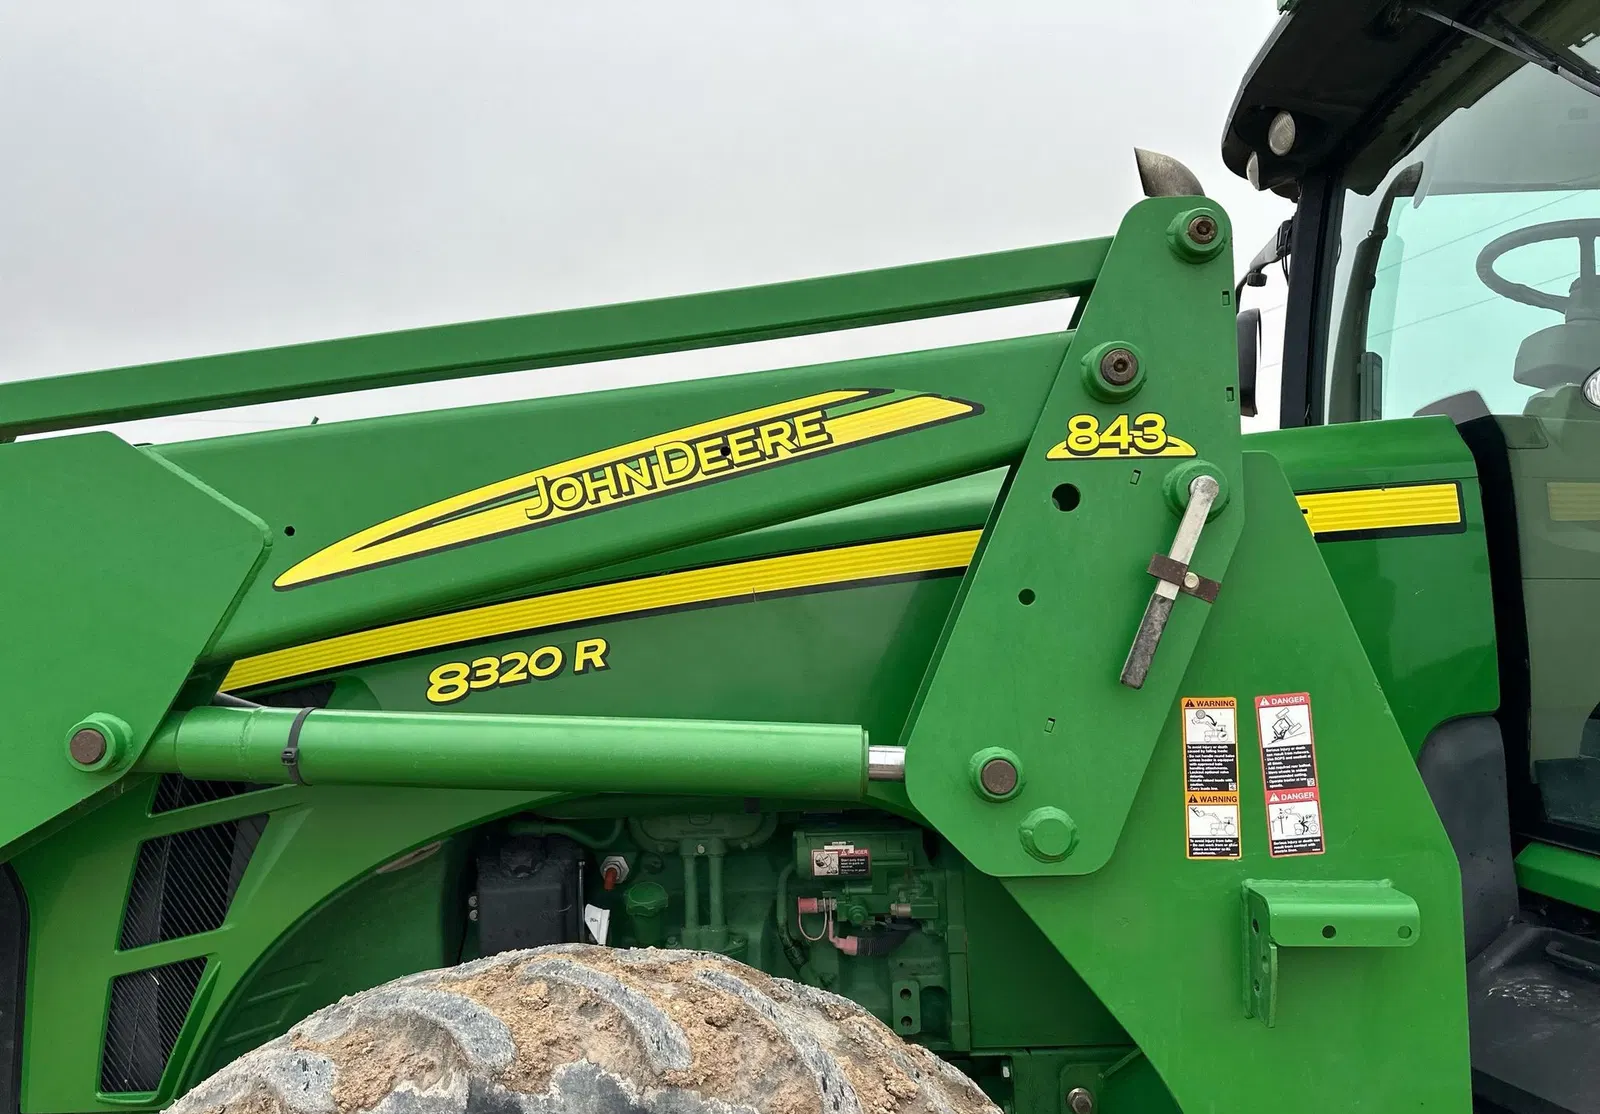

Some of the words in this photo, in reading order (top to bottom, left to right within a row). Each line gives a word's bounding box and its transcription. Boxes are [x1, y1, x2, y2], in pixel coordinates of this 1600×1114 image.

[524, 457, 655, 520] JOHN
[654, 410, 833, 486] DEERE
[1066, 412, 1168, 456] 843
[426, 645, 566, 706] 8320
[573, 636, 611, 675] R
